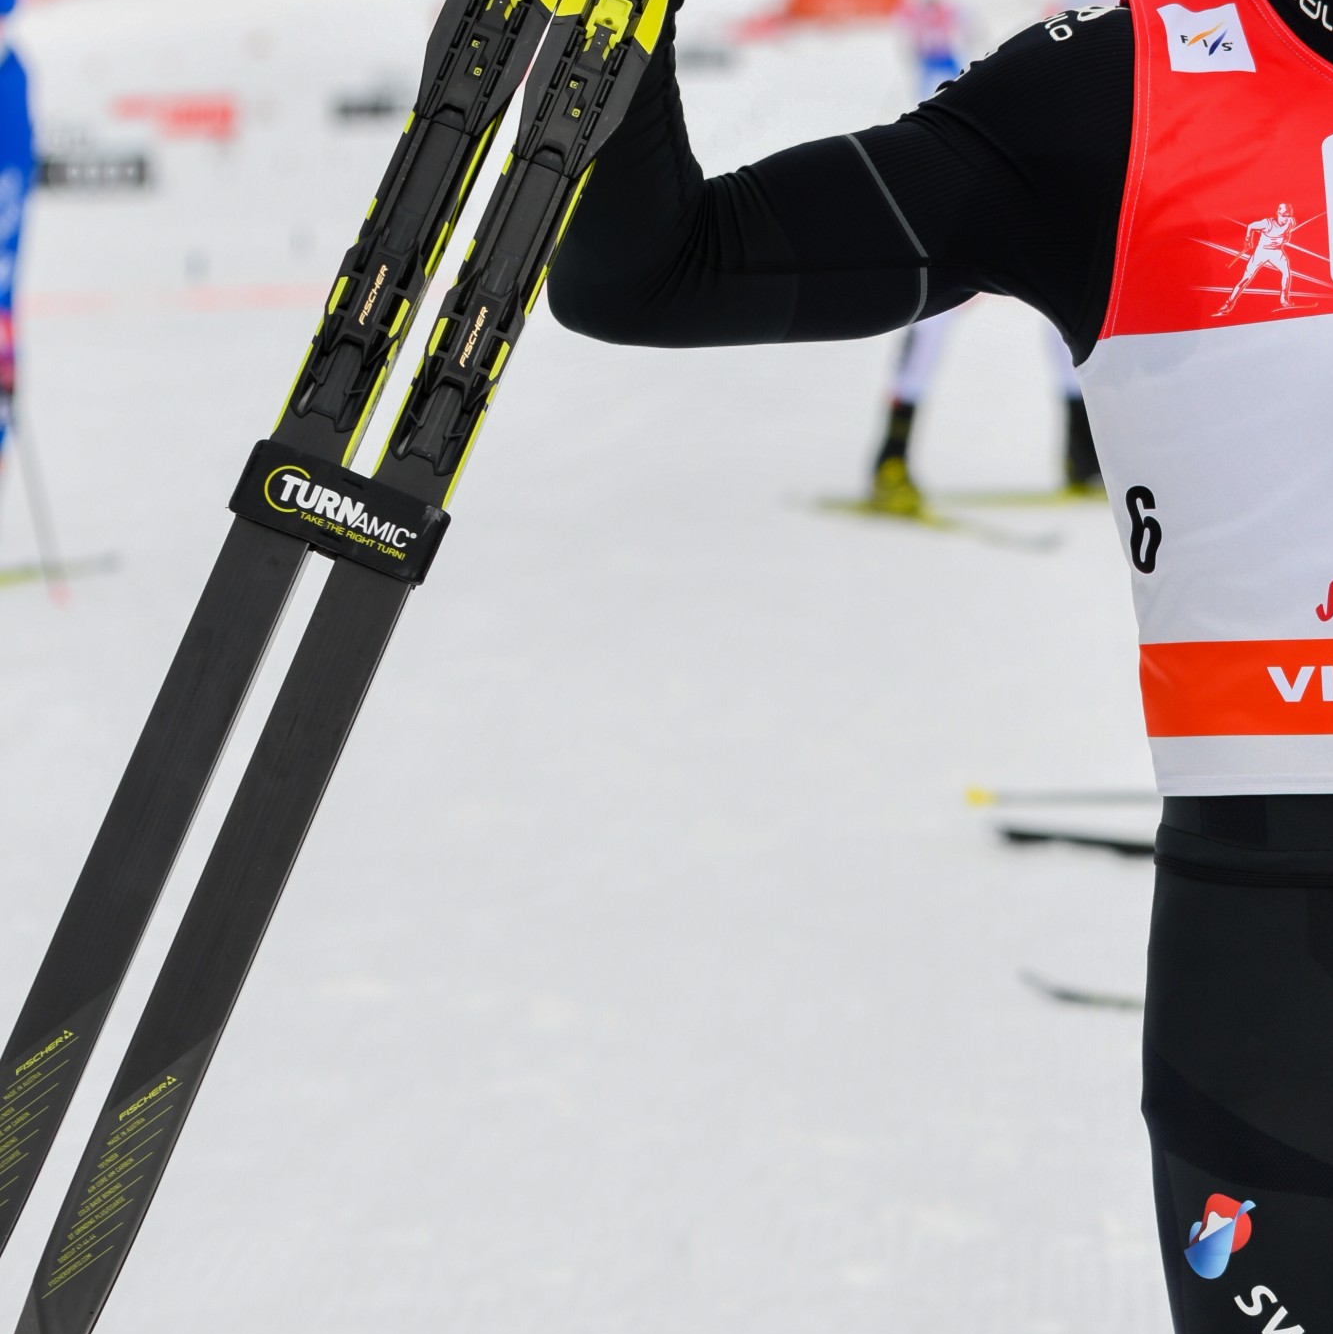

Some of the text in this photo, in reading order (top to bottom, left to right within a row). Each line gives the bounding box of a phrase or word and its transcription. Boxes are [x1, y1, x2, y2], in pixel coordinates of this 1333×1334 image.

[358, 264, 388, 326] FISCHER
[459, 306, 489, 368] FISCHER
[300, 511, 406, 561] TAKE THE RIGHT TURN!
[1125, 485, 1162, 574] 6
[15, 1036, 64, 1076] FISCHER
[118, 1082, 167, 1121] FISCHER
